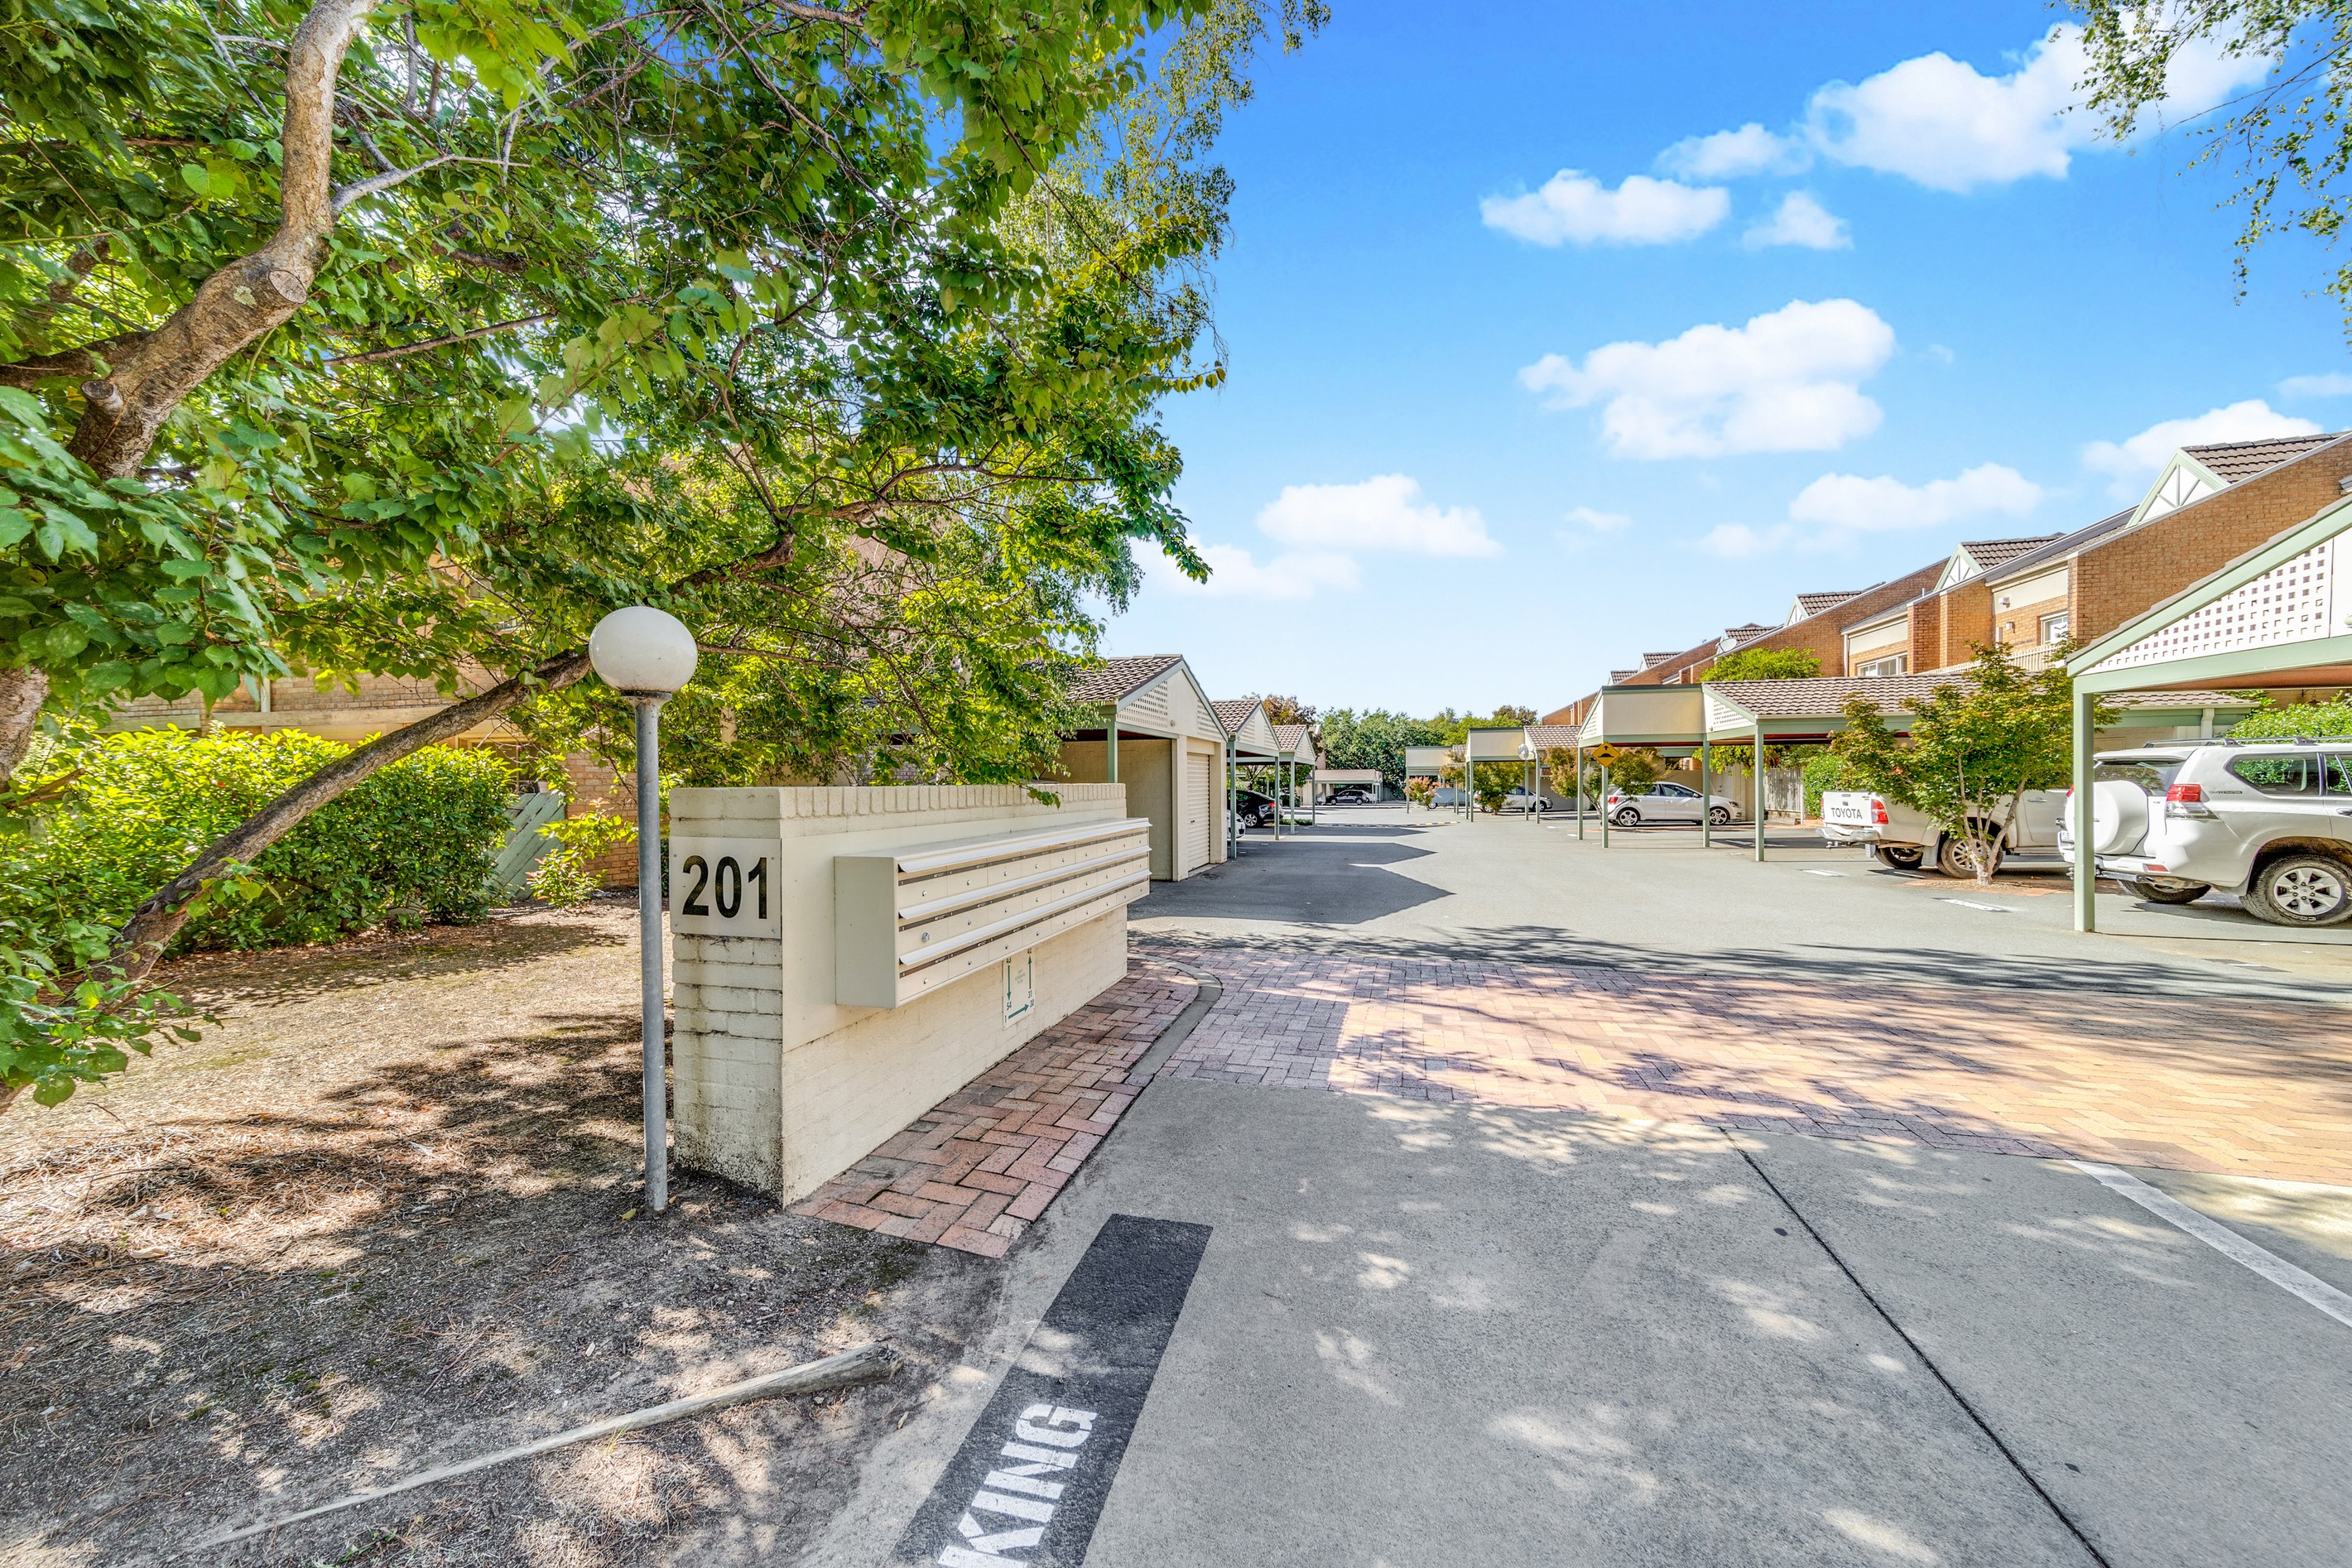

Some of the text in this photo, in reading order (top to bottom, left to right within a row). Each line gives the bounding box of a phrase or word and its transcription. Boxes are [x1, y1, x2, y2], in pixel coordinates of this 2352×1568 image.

[1830, 807, 1863, 820] TOYOTA
[681, 854, 767, 920] 201
[937, 1403, 1099, 1568] KING
